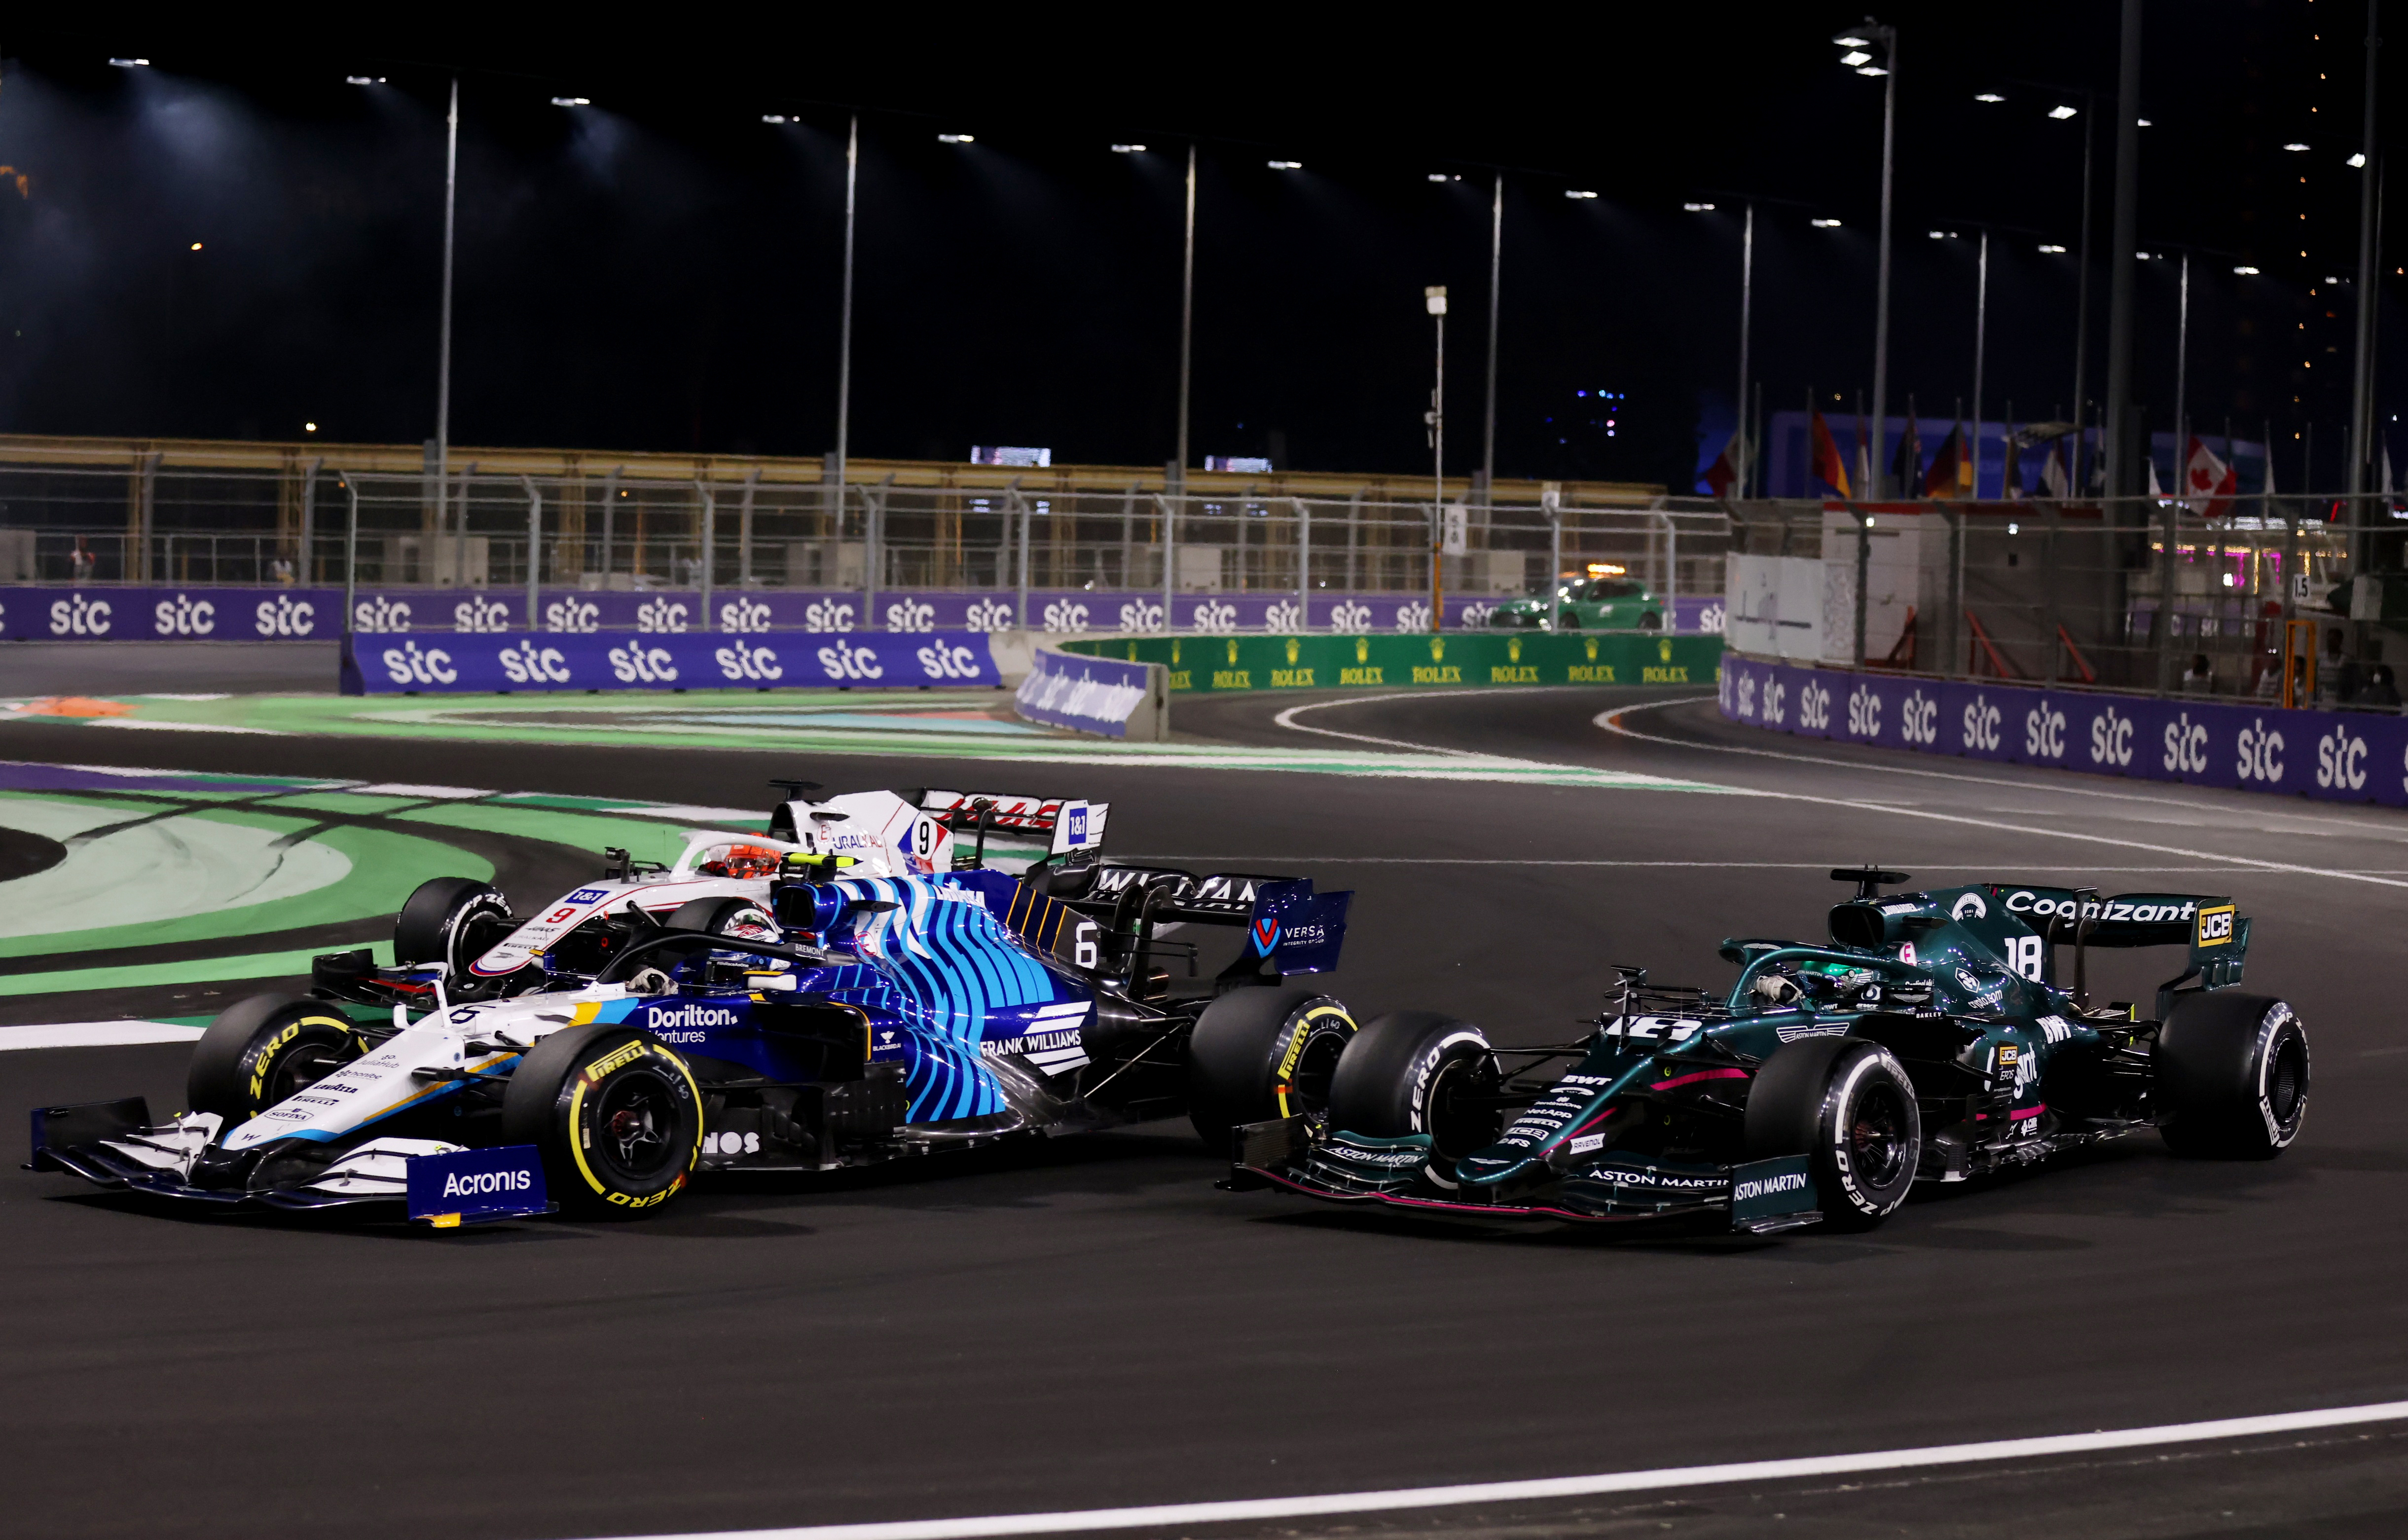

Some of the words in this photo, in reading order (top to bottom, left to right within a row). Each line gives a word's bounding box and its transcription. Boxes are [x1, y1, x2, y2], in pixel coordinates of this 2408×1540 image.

[50, 593, 111, 634] stc
[155, 594, 214, 634] stc
[256, 595, 314, 636] stc
[356, 595, 411, 632] stc
[455, 595, 509, 632] stc
[547, 596, 599, 633] stc
[637, 597, 688, 633] stc
[721, 597, 771, 633] stc
[806, 597, 854, 633] stc
[888, 598, 935, 633] stc
[966, 598, 1012, 633] stc
[1044, 598, 1089, 632] stc
[1120, 598, 1163, 633] stc
[1194, 599, 1236, 633] stc
[1332, 600, 1371, 634] stc
[383, 641, 457, 684] stc
[499, 639, 571, 683] stc
[608, 639, 678, 682] stc
[716, 639, 782, 680] stc
[818, 639, 883, 679] stc
[916, 638, 980, 679] stc
[1340, 667, 1383, 685] ROLEX
[1413, 666, 1462, 683] ROLEX
[1491, 666, 1538, 683] ROLEX
[1569, 665, 1614, 682] ROLEX
[1643, 666, 1687, 683] ROLEX
[1271, 668, 1314, 687] ROLEX
[1800, 678, 1829, 729] stc
[1849, 684, 1881, 736] stc
[1902, 690, 1936, 744] stc
[1963, 695, 2000, 751] stc
[2026, 700, 2066, 758] stc
[2091, 706, 2133, 766] stc
[2163, 712, 2208, 773] stc
[2237, 718, 2284, 782] stc
[2318, 724, 2367, 789] stc
[919, 822, 930, 854] 9
[1070, 814, 1086, 835] 1&1
[573, 891, 603, 901] 1&1
[2006, 891, 2196, 928] Cognizant
[546, 908, 577, 923] 9
[1285, 925, 1325, 939] VERSA
[2201, 913, 2231, 939] JCB
[795, 943, 825, 957] BREMONT
[1076, 921, 1097, 969] 6
[2005, 935, 2042, 982] 18
[1968, 989, 2003, 1009] crypto.com
[980, 1036, 1024, 1058] FRANK
[1024, 1029, 1081, 1052] WILLIAMS
[2036, 1015, 2072, 1044] BWT
[250, 1022, 299, 1100] ZERO
[357, 1060, 400, 1068] JuliaHub
[584, 1039, 647, 1082] PIRELLI
[1277, 1018, 1311, 1080] PIRELLI
[2002, 1049, 2017, 1061] JCB
[313, 1084, 358, 1094] LAVAZZA
[351, 1071, 382, 1080] honibe
[1411, 1046, 1441, 1134] ZERO
[1561, 1074, 1613, 1086] BWT
[1880, 1052, 1915, 1100] PIRELLI
[2000, 1069, 2015, 1081] EPOS
[269, 1111, 307, 1121] SOFINA
[291, 1096, 340, 1105] PIRELLI
[1524, 1108, 1573, 1119] NetApp
[1329, 1145, 1375, 1162] ASTON
[1374, 1153, 1425, 1165] MARTIN
[1574, 1139, 1601, 1149] RAVENOL
[443, 1170, 531, 1198] Acronis
[606, 1173, 685, 1208] ZERO
[1589, 1169, 1655, 1185] ASTON
[1734, 1179, 1762, 1202] ASTON
[1764, 1173, 1806, 1198] MARTIN
[1835, 1150, 1878, 1214] ZERO
